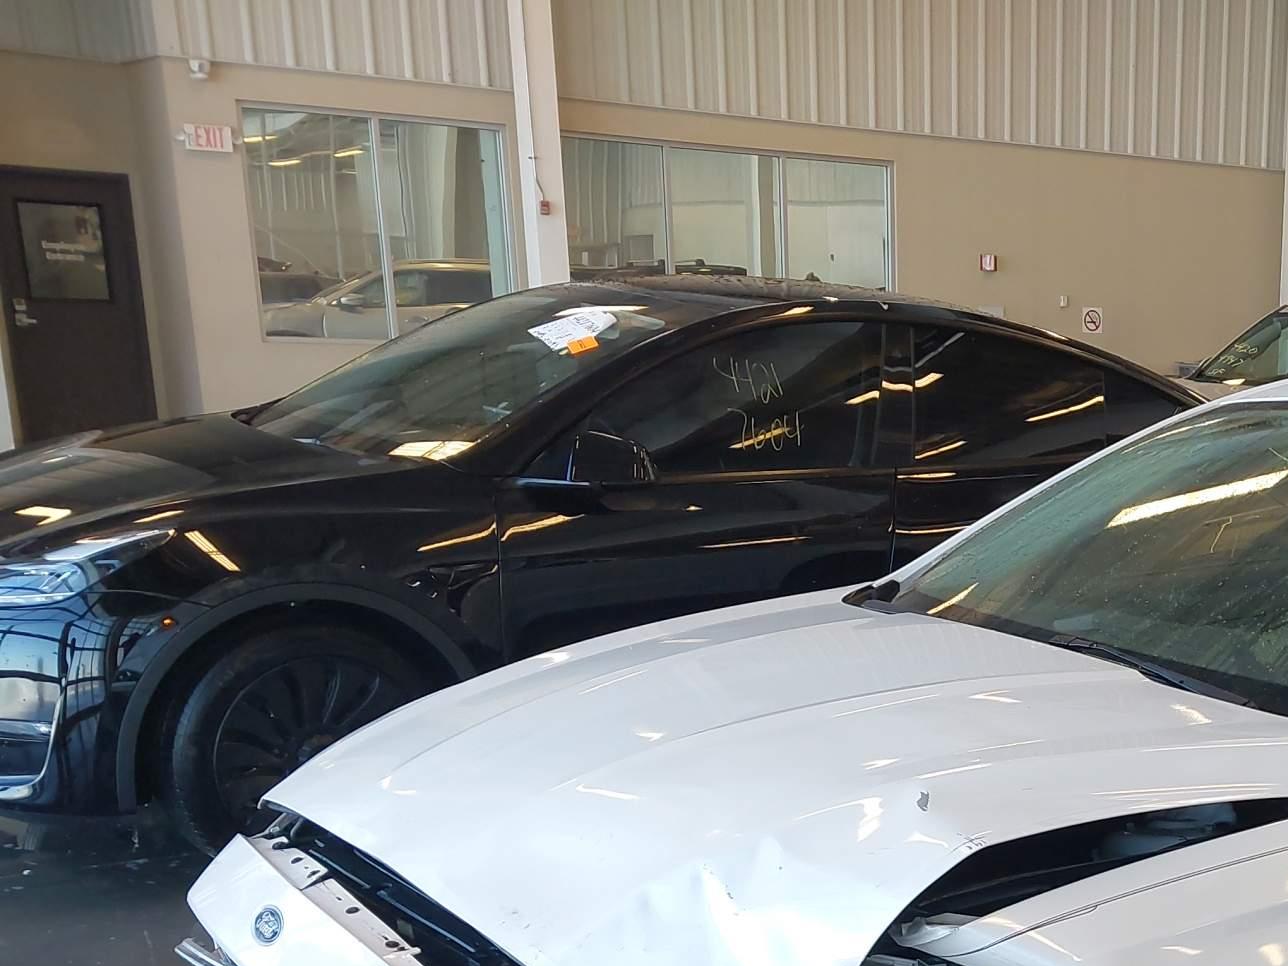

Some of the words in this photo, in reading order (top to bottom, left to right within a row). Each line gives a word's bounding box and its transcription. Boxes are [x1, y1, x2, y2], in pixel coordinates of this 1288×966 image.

[194, 127, 225, 150] EXIT
[712, 356, 784, 404] 4421
[727, 407, 804, 451] 7604
